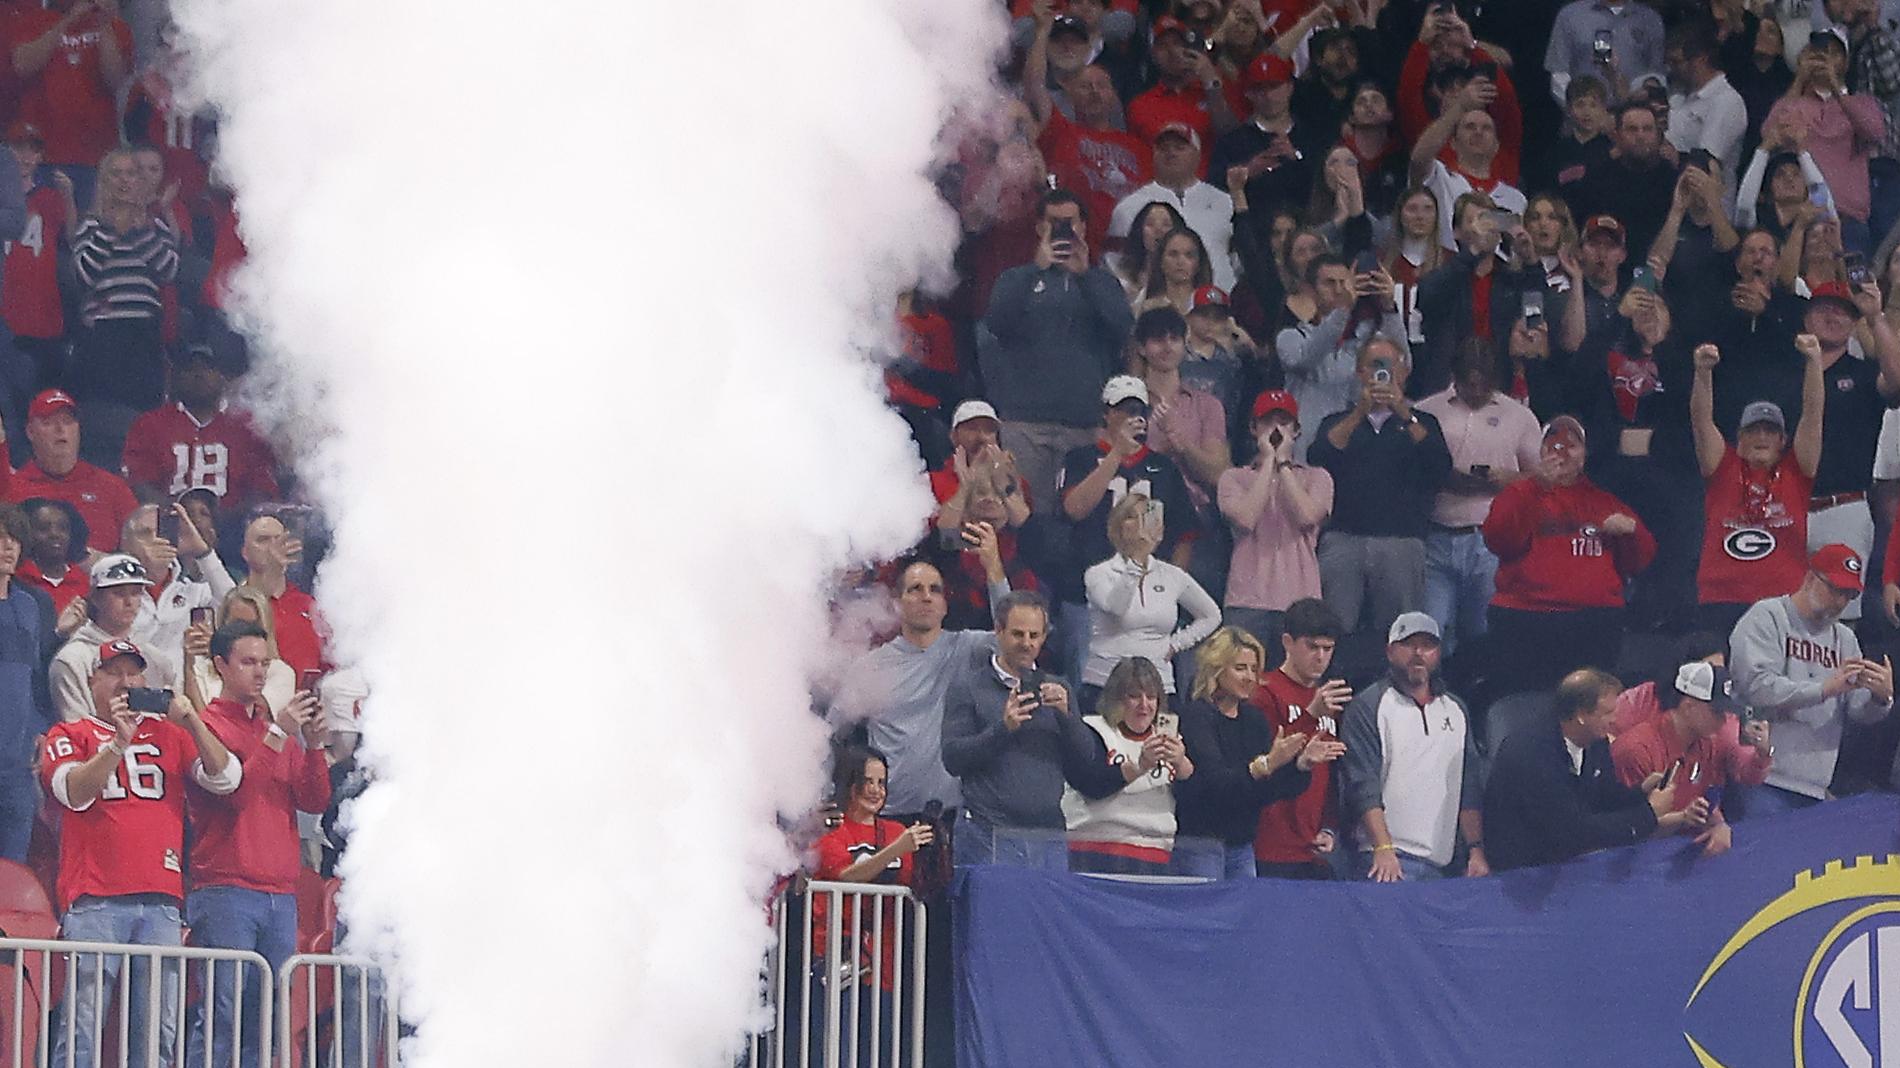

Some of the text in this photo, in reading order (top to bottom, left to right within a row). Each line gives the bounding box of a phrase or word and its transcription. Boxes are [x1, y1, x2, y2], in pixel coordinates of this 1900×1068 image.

[169, 443, 229, 497] 18
[1723, 527, 1777, 561] G
[47, 736, 73, 762] 16
